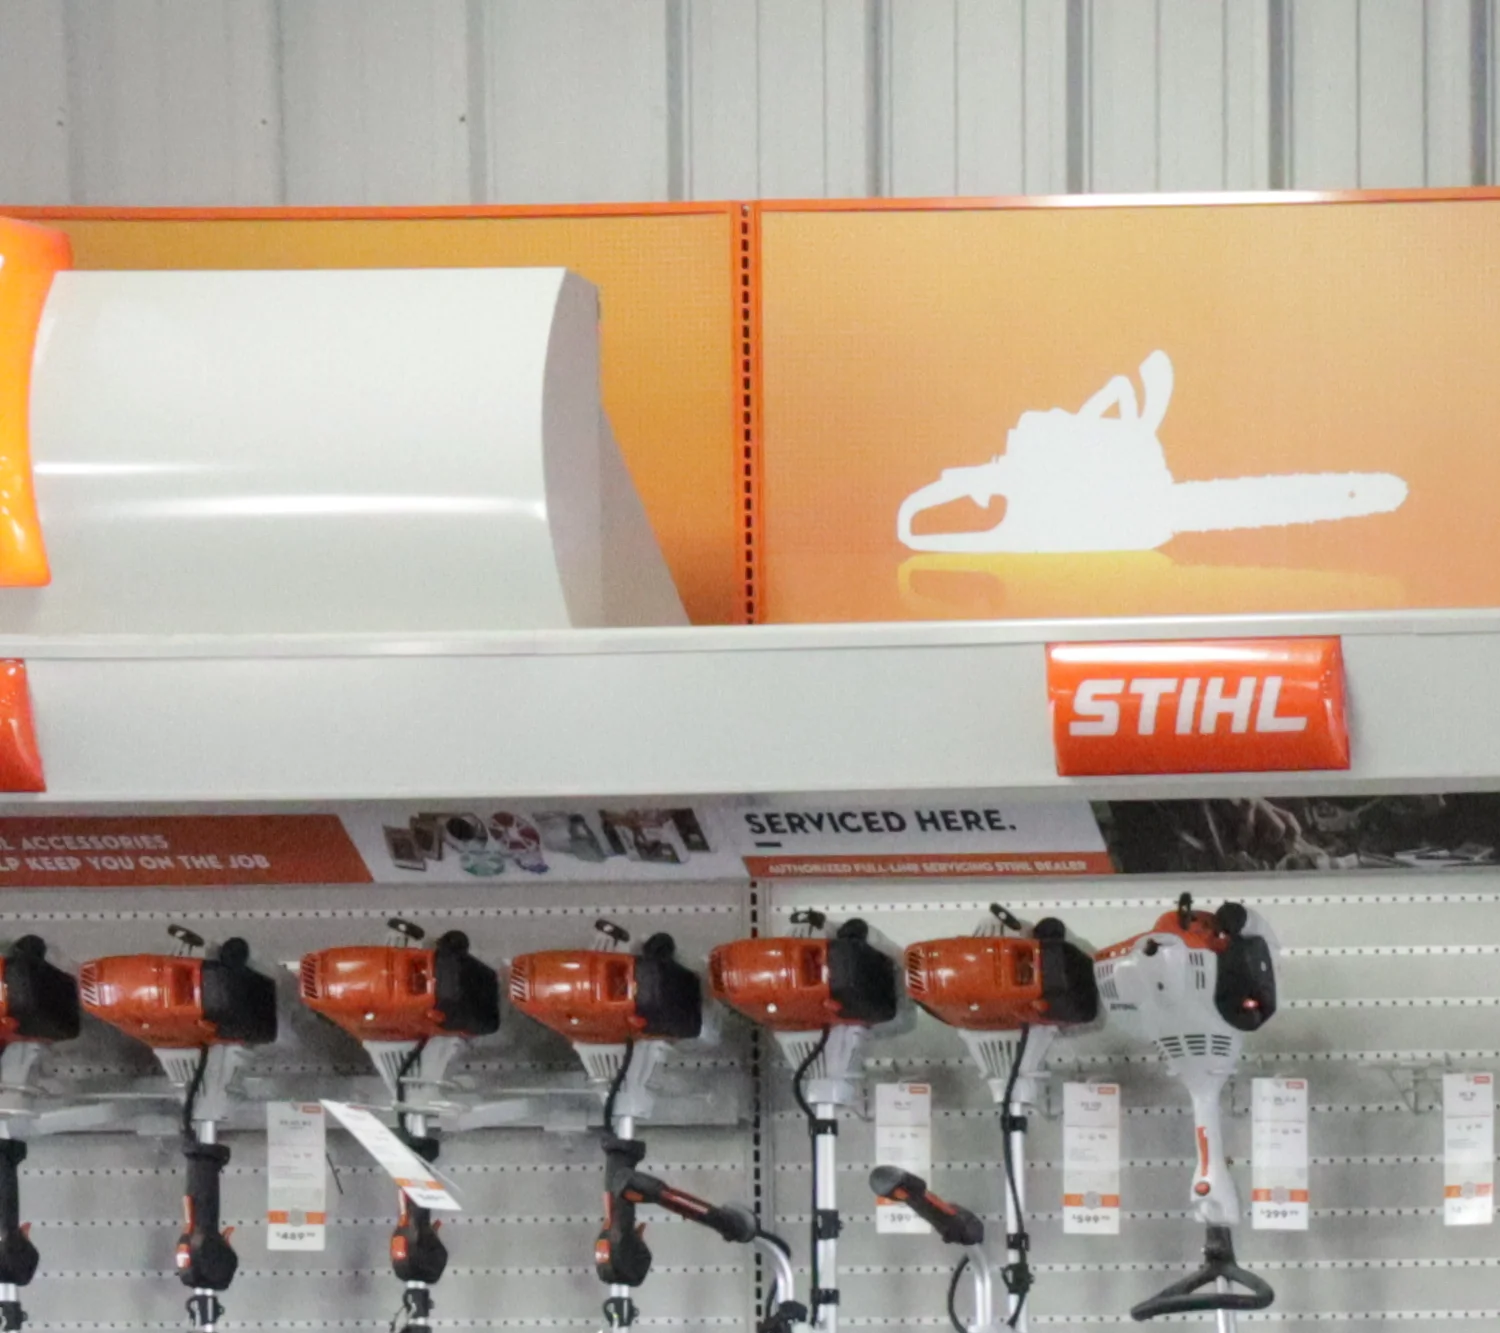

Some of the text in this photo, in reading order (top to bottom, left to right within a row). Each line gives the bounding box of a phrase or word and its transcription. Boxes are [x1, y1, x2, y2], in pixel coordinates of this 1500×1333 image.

[1069, 676, 1308, 736] STIHL
[744, 808, 1017, 835] SERVICED HERE.
[22, 834, 169, 851] ACCESSORIES
[24, 856, 82, 871] KEEP
[86, 855, 135, 871] YOU
[138, 855, 175, 870] ON
[177, 854, 224, 870] THE
[229, 854, 270, 869] JOB
